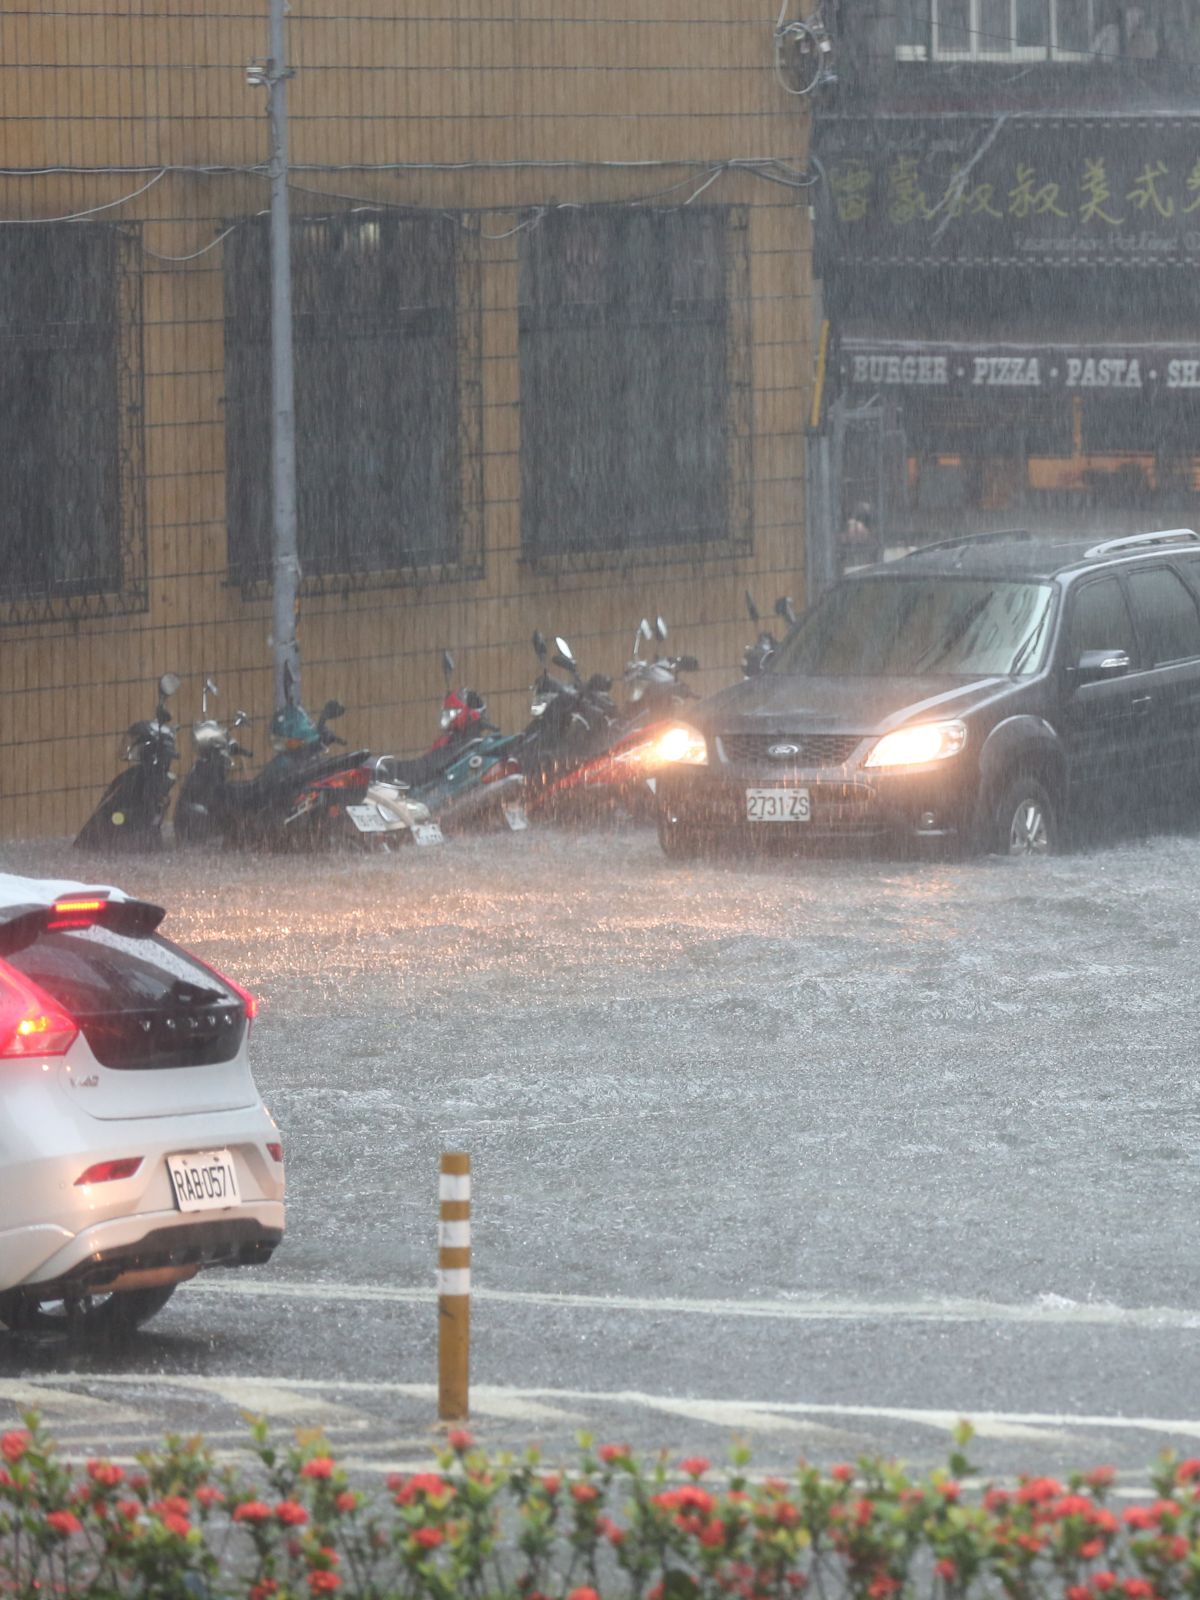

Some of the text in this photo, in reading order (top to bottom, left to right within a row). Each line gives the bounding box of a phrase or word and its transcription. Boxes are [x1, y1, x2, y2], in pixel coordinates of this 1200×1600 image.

[852, 355, 948, 384] BURGER
[972, 357, 1042, 386] PIZZA
[1066, 358, 1143, 387] PASTA
[174, 1164, 236, 1203] RAB-0571
